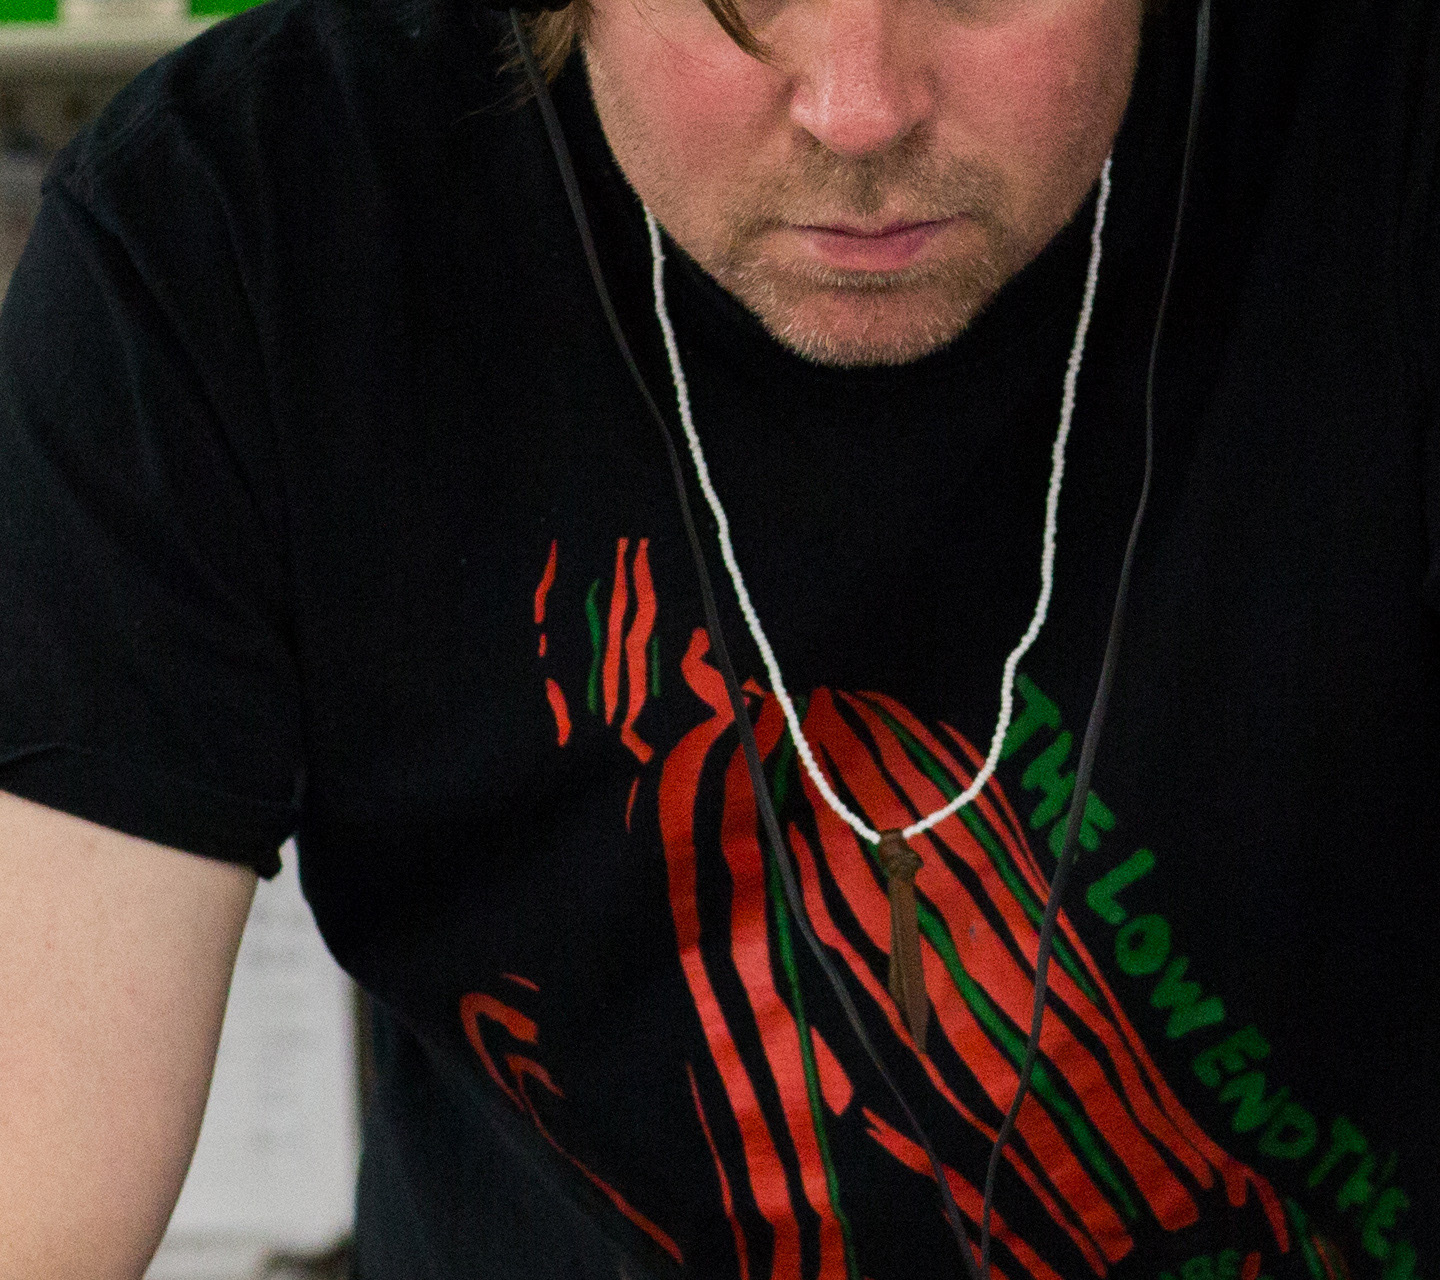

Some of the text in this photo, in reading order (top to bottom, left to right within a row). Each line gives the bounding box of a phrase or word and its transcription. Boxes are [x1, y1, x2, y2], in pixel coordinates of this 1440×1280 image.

[1000, 672, 1118, 862] THE
[1085, 847, 1225, 1040] LOW
[1192, 1025, 1319, 1160] END
